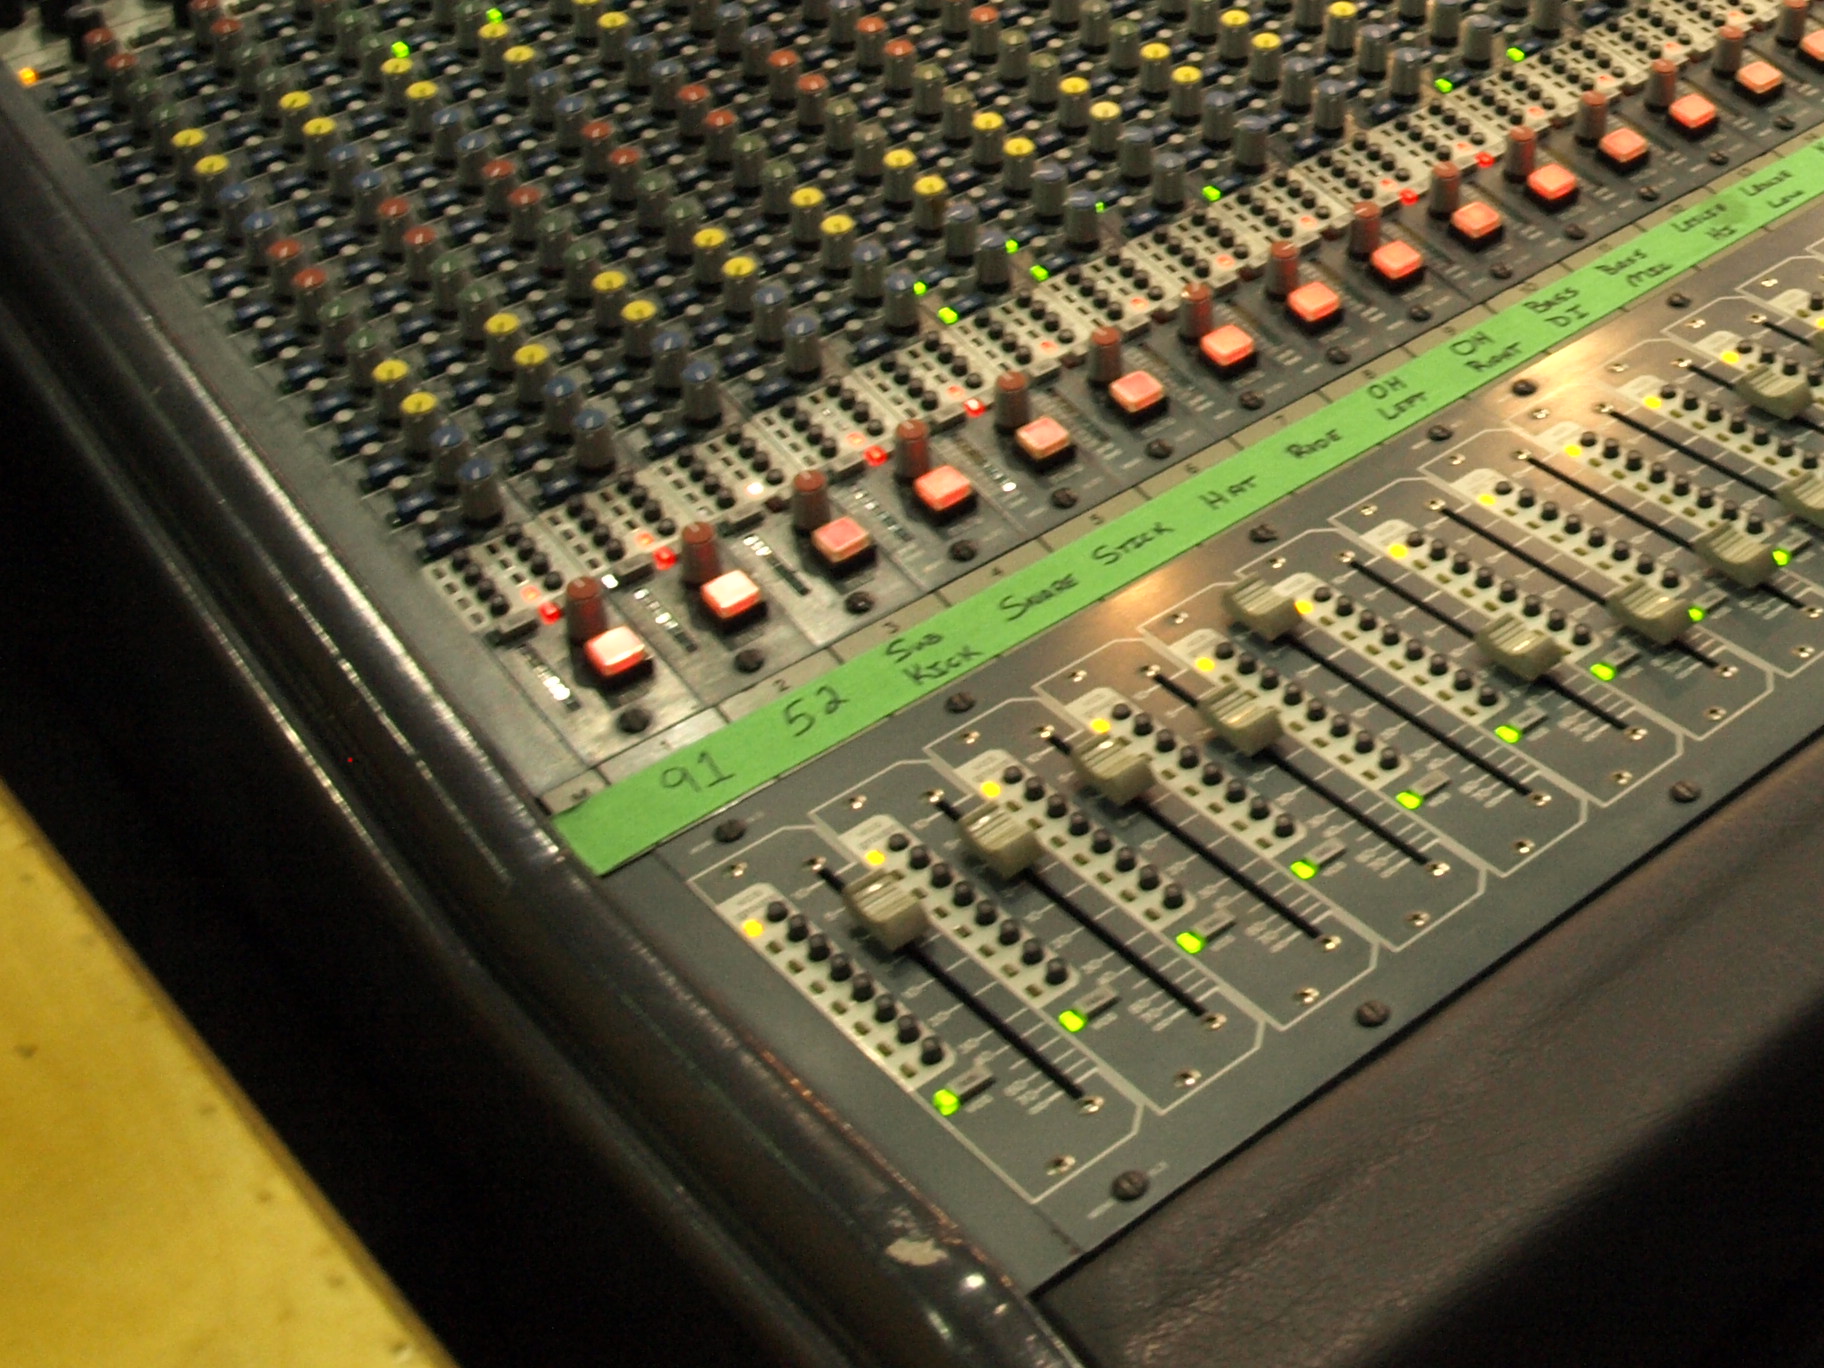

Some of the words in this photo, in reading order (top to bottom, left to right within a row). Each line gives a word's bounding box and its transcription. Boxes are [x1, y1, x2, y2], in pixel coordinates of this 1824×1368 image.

[1377, 390, 1428, 422] LEFT
[1197, 474, 1258, 511] HAT
[1091, 521, 1176, 566] STICK
[772, 678, 791, 693] 2
[783, 685, 850, 738] 52
[659, 750, 736, 794] 91
